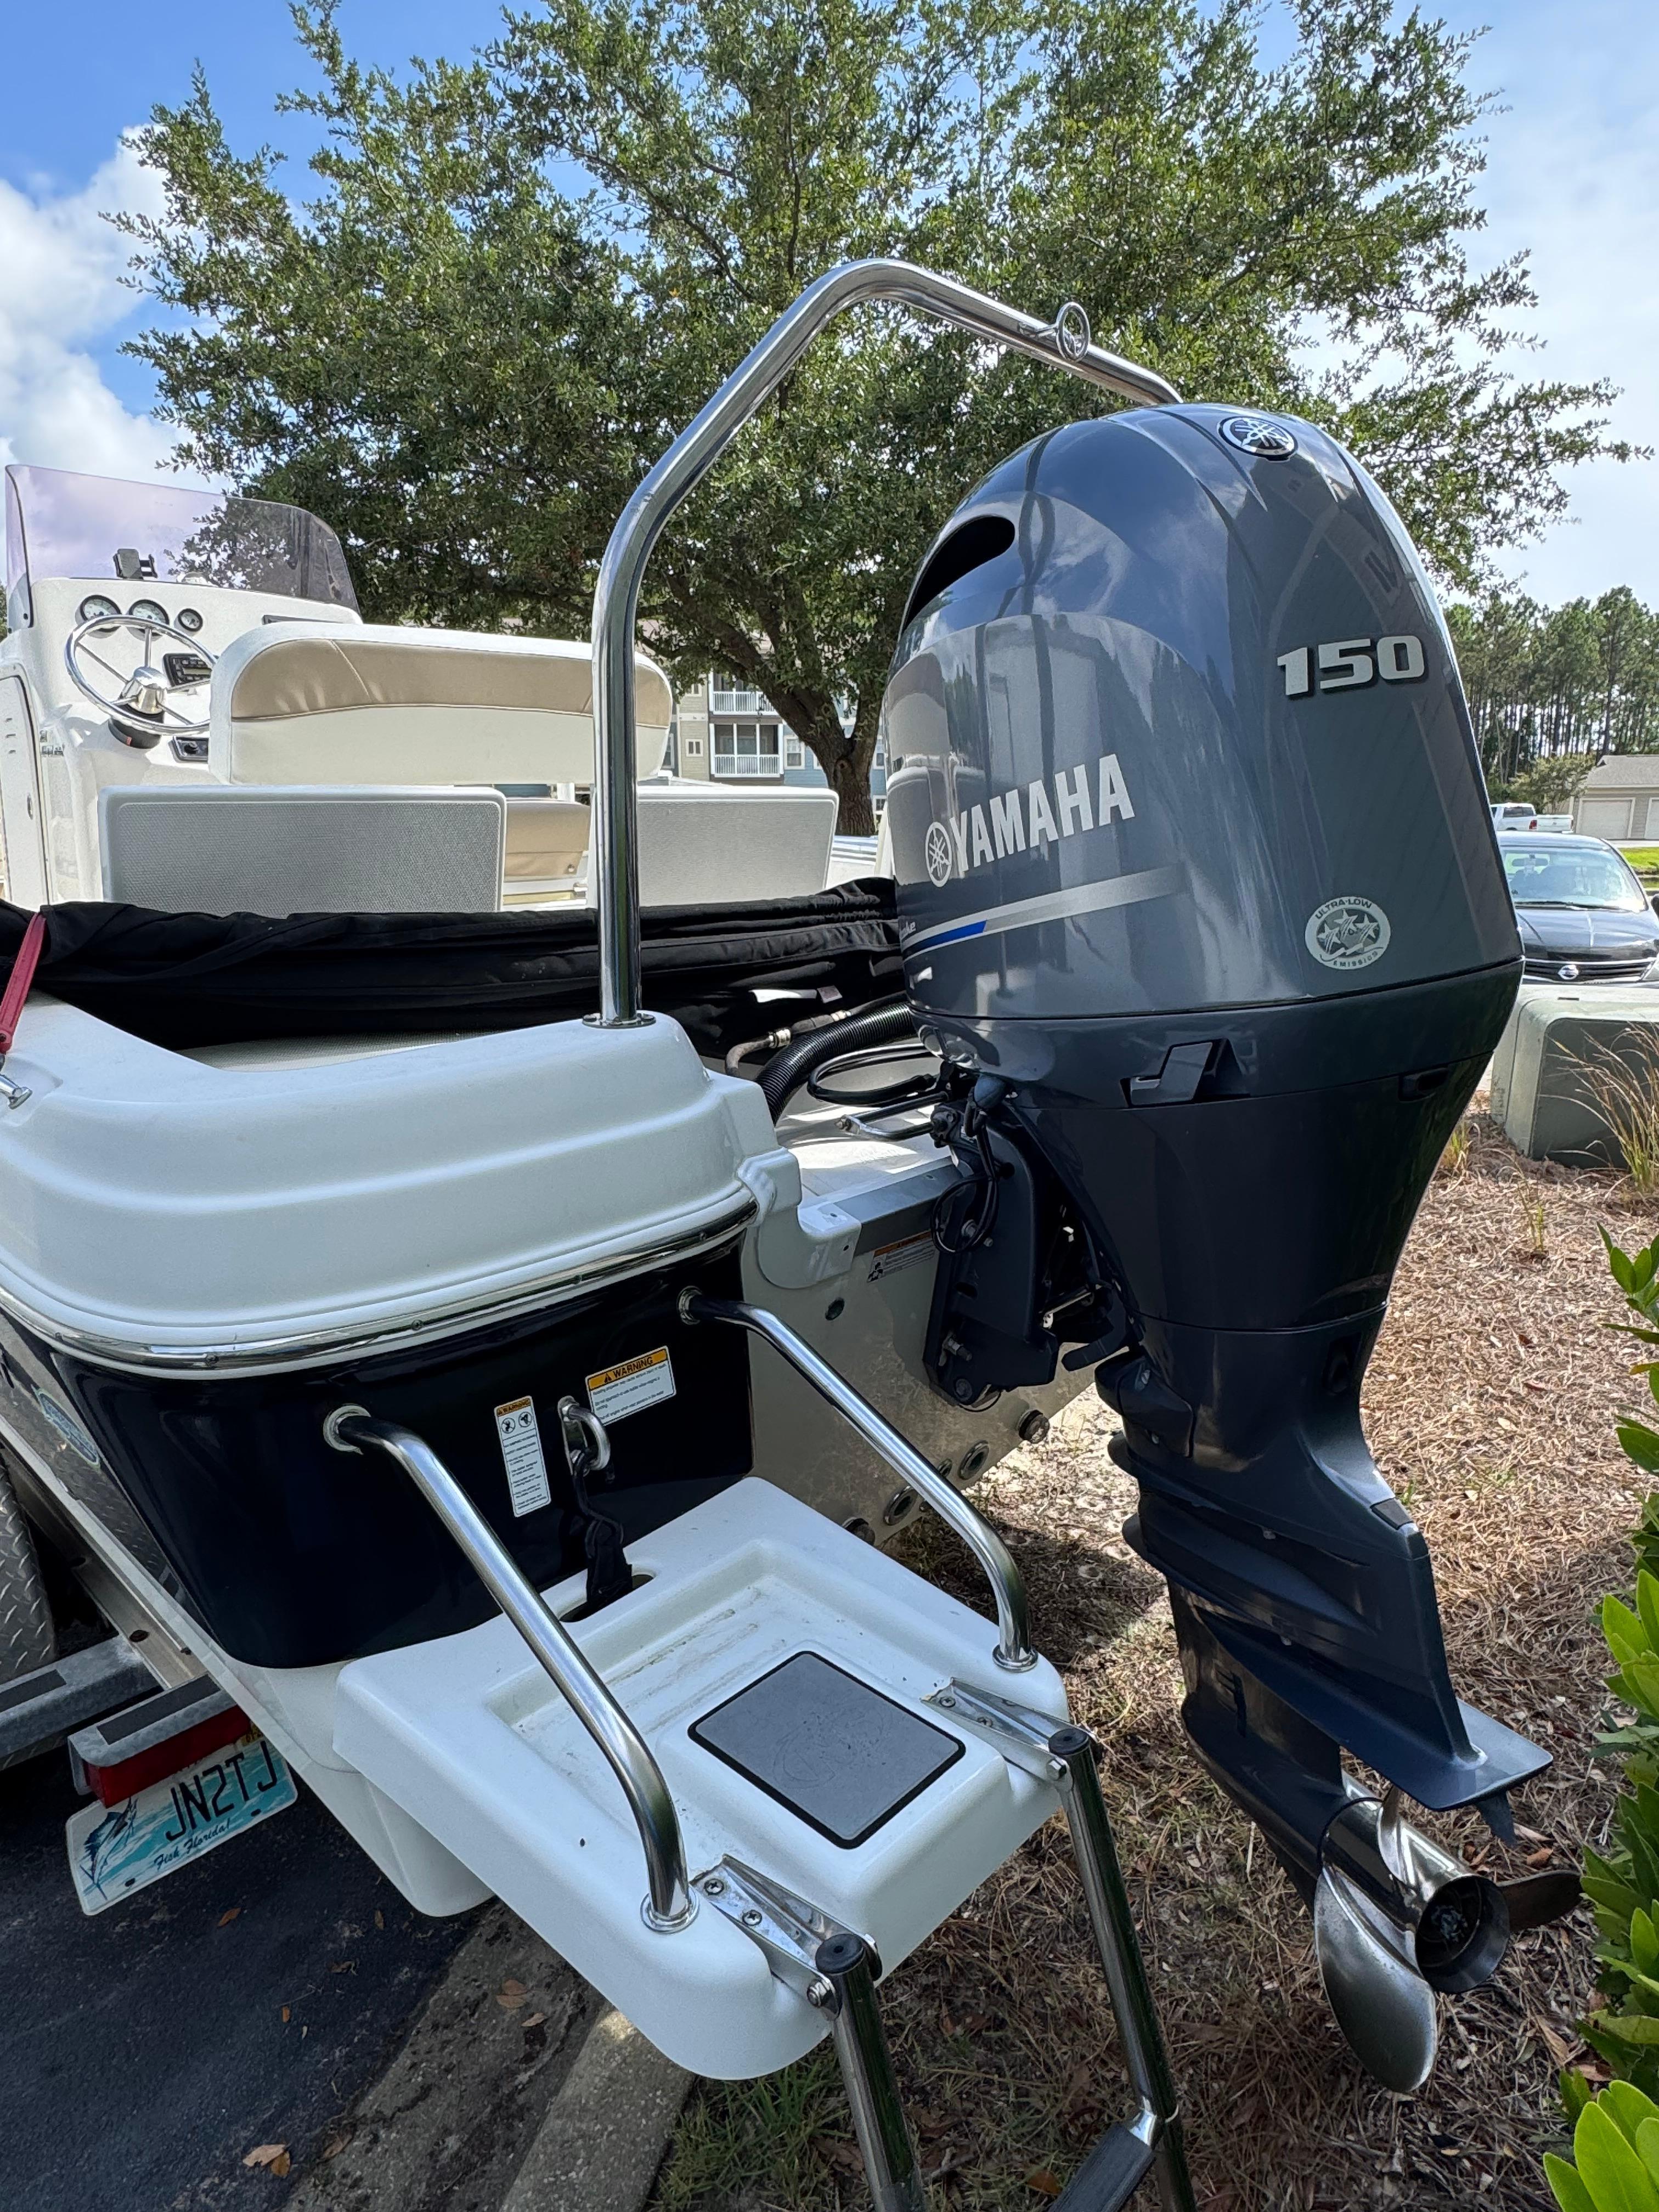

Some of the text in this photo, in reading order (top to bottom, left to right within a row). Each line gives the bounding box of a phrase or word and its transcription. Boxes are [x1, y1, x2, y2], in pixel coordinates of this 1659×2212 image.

[1277, 635, 1424, 696] 150
[949, 754, 1135, 872] YAMAHA
[613, 1356, 653, 1378] WARNING
[154, 1847, 179, 1870] Fish
